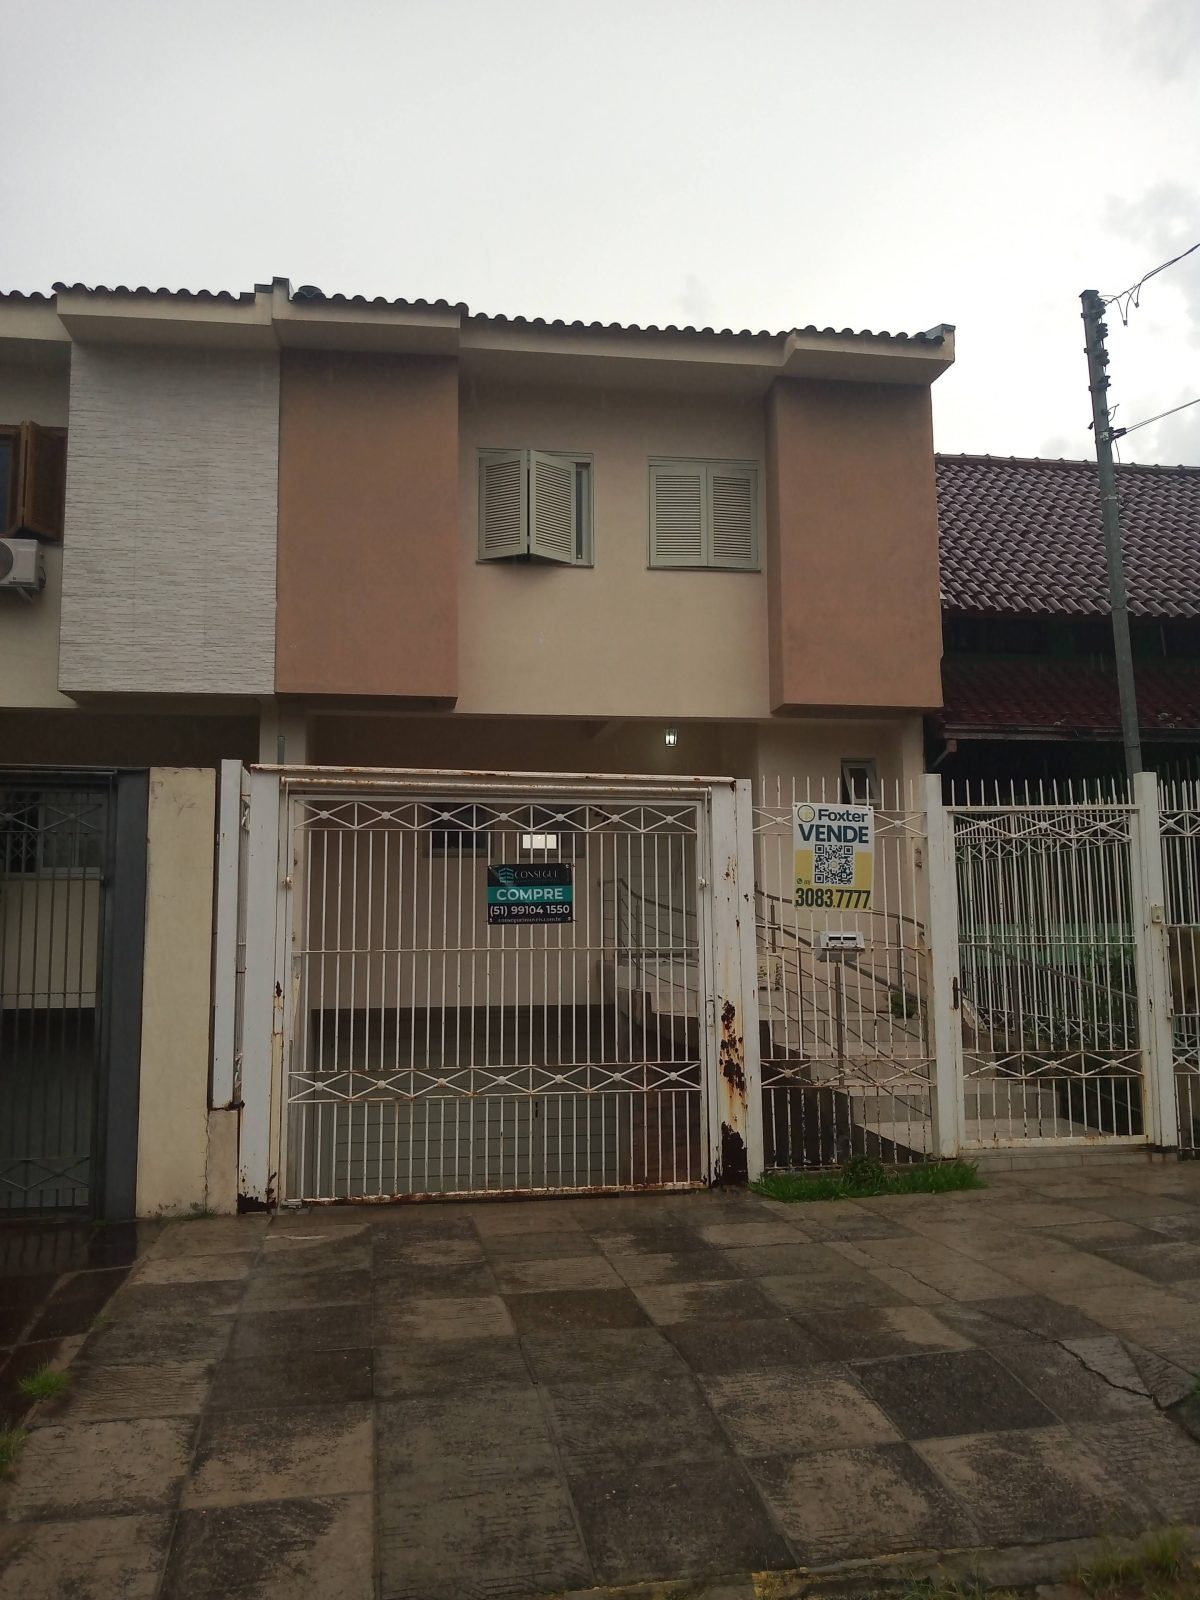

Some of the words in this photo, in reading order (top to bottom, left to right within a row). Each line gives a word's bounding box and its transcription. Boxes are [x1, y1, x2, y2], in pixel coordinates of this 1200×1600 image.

[818, 809, 868, 822] Foxter
[798, 824, 869, 844] VENDE
[496, 888, 563, 900] COMPRE
[795, 888, 871, 909] 3083.7777
[490, 906, 507, 916] (51)
[511, 905, 543, 914] 99104
[546, 905, 570, 914] 1550
